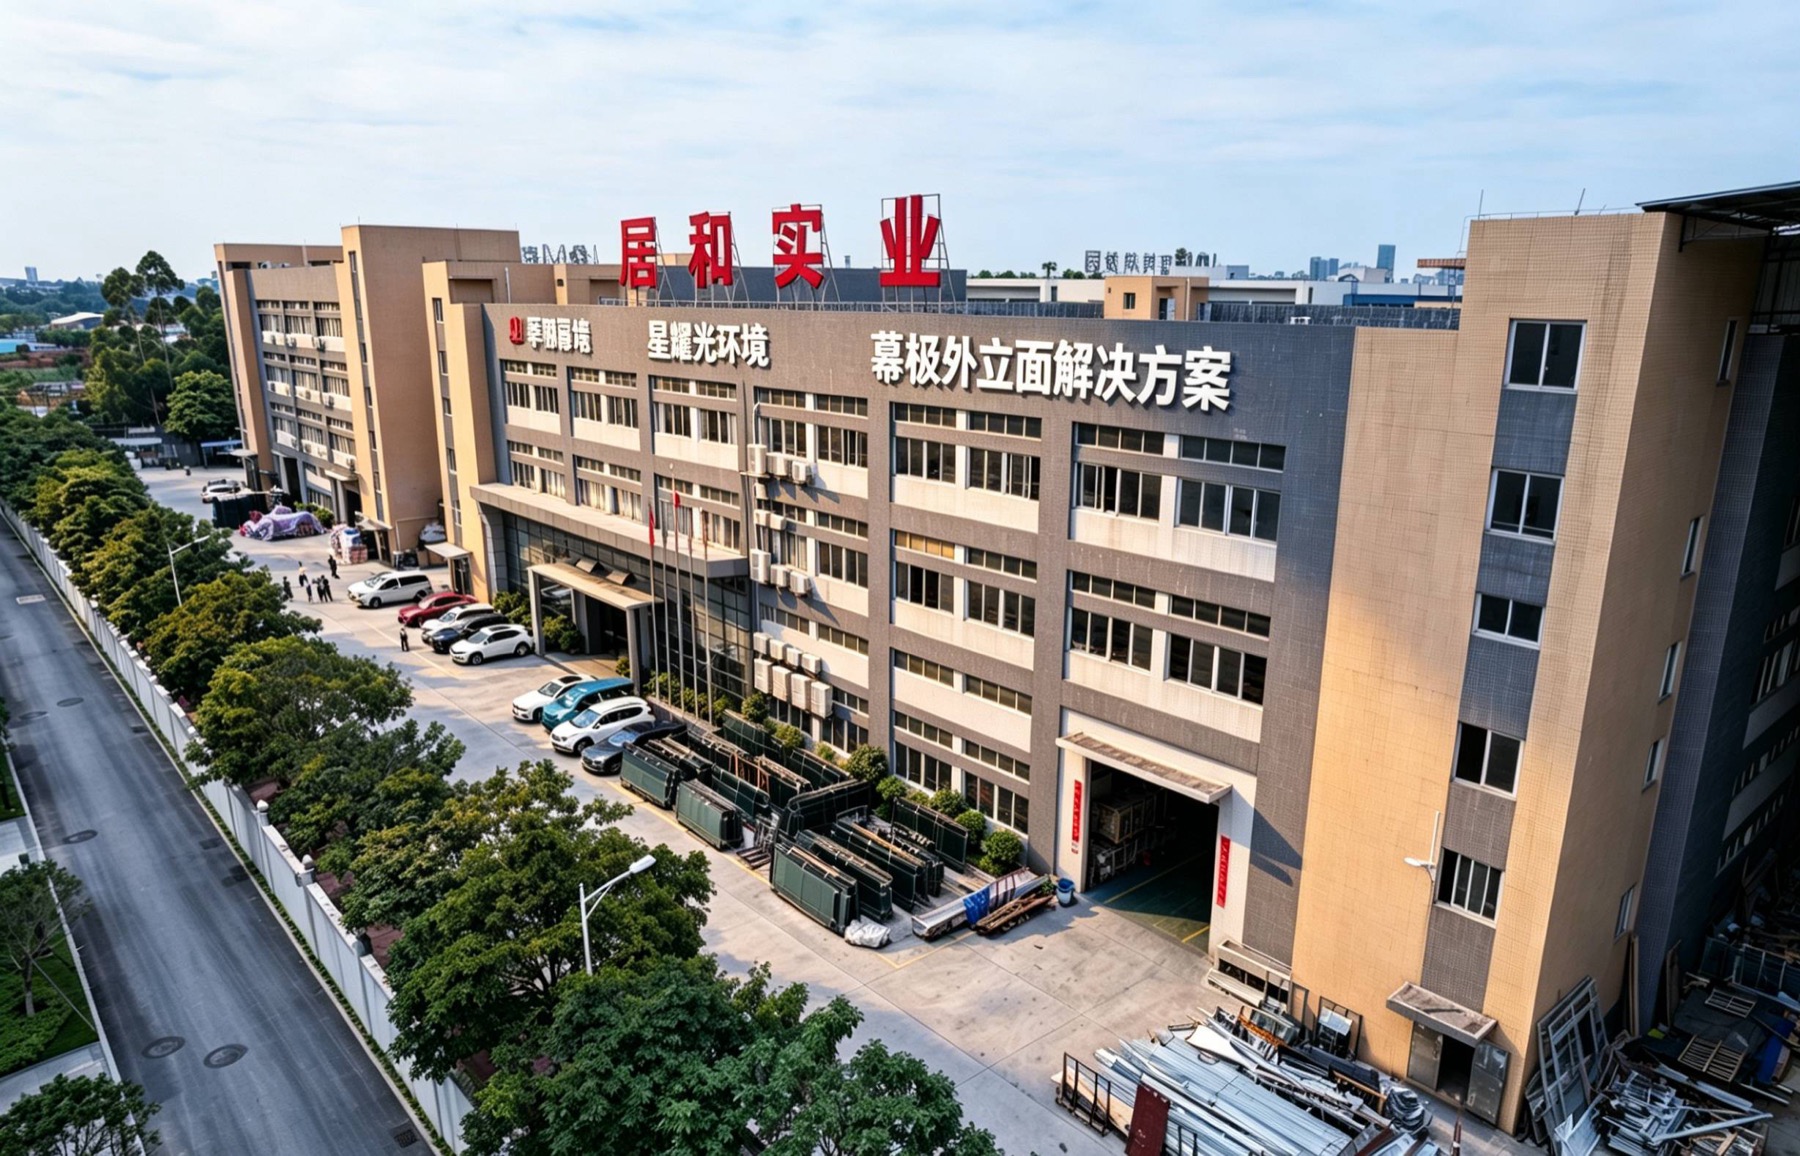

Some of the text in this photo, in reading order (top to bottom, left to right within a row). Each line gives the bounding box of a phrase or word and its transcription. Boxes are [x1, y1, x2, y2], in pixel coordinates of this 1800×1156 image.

[619, 194, 941, 289] 居和实业
[647, 320, 770, 367] 星耀光环境
[870, 330, 1232, 411] 幕极外立面解决方案
